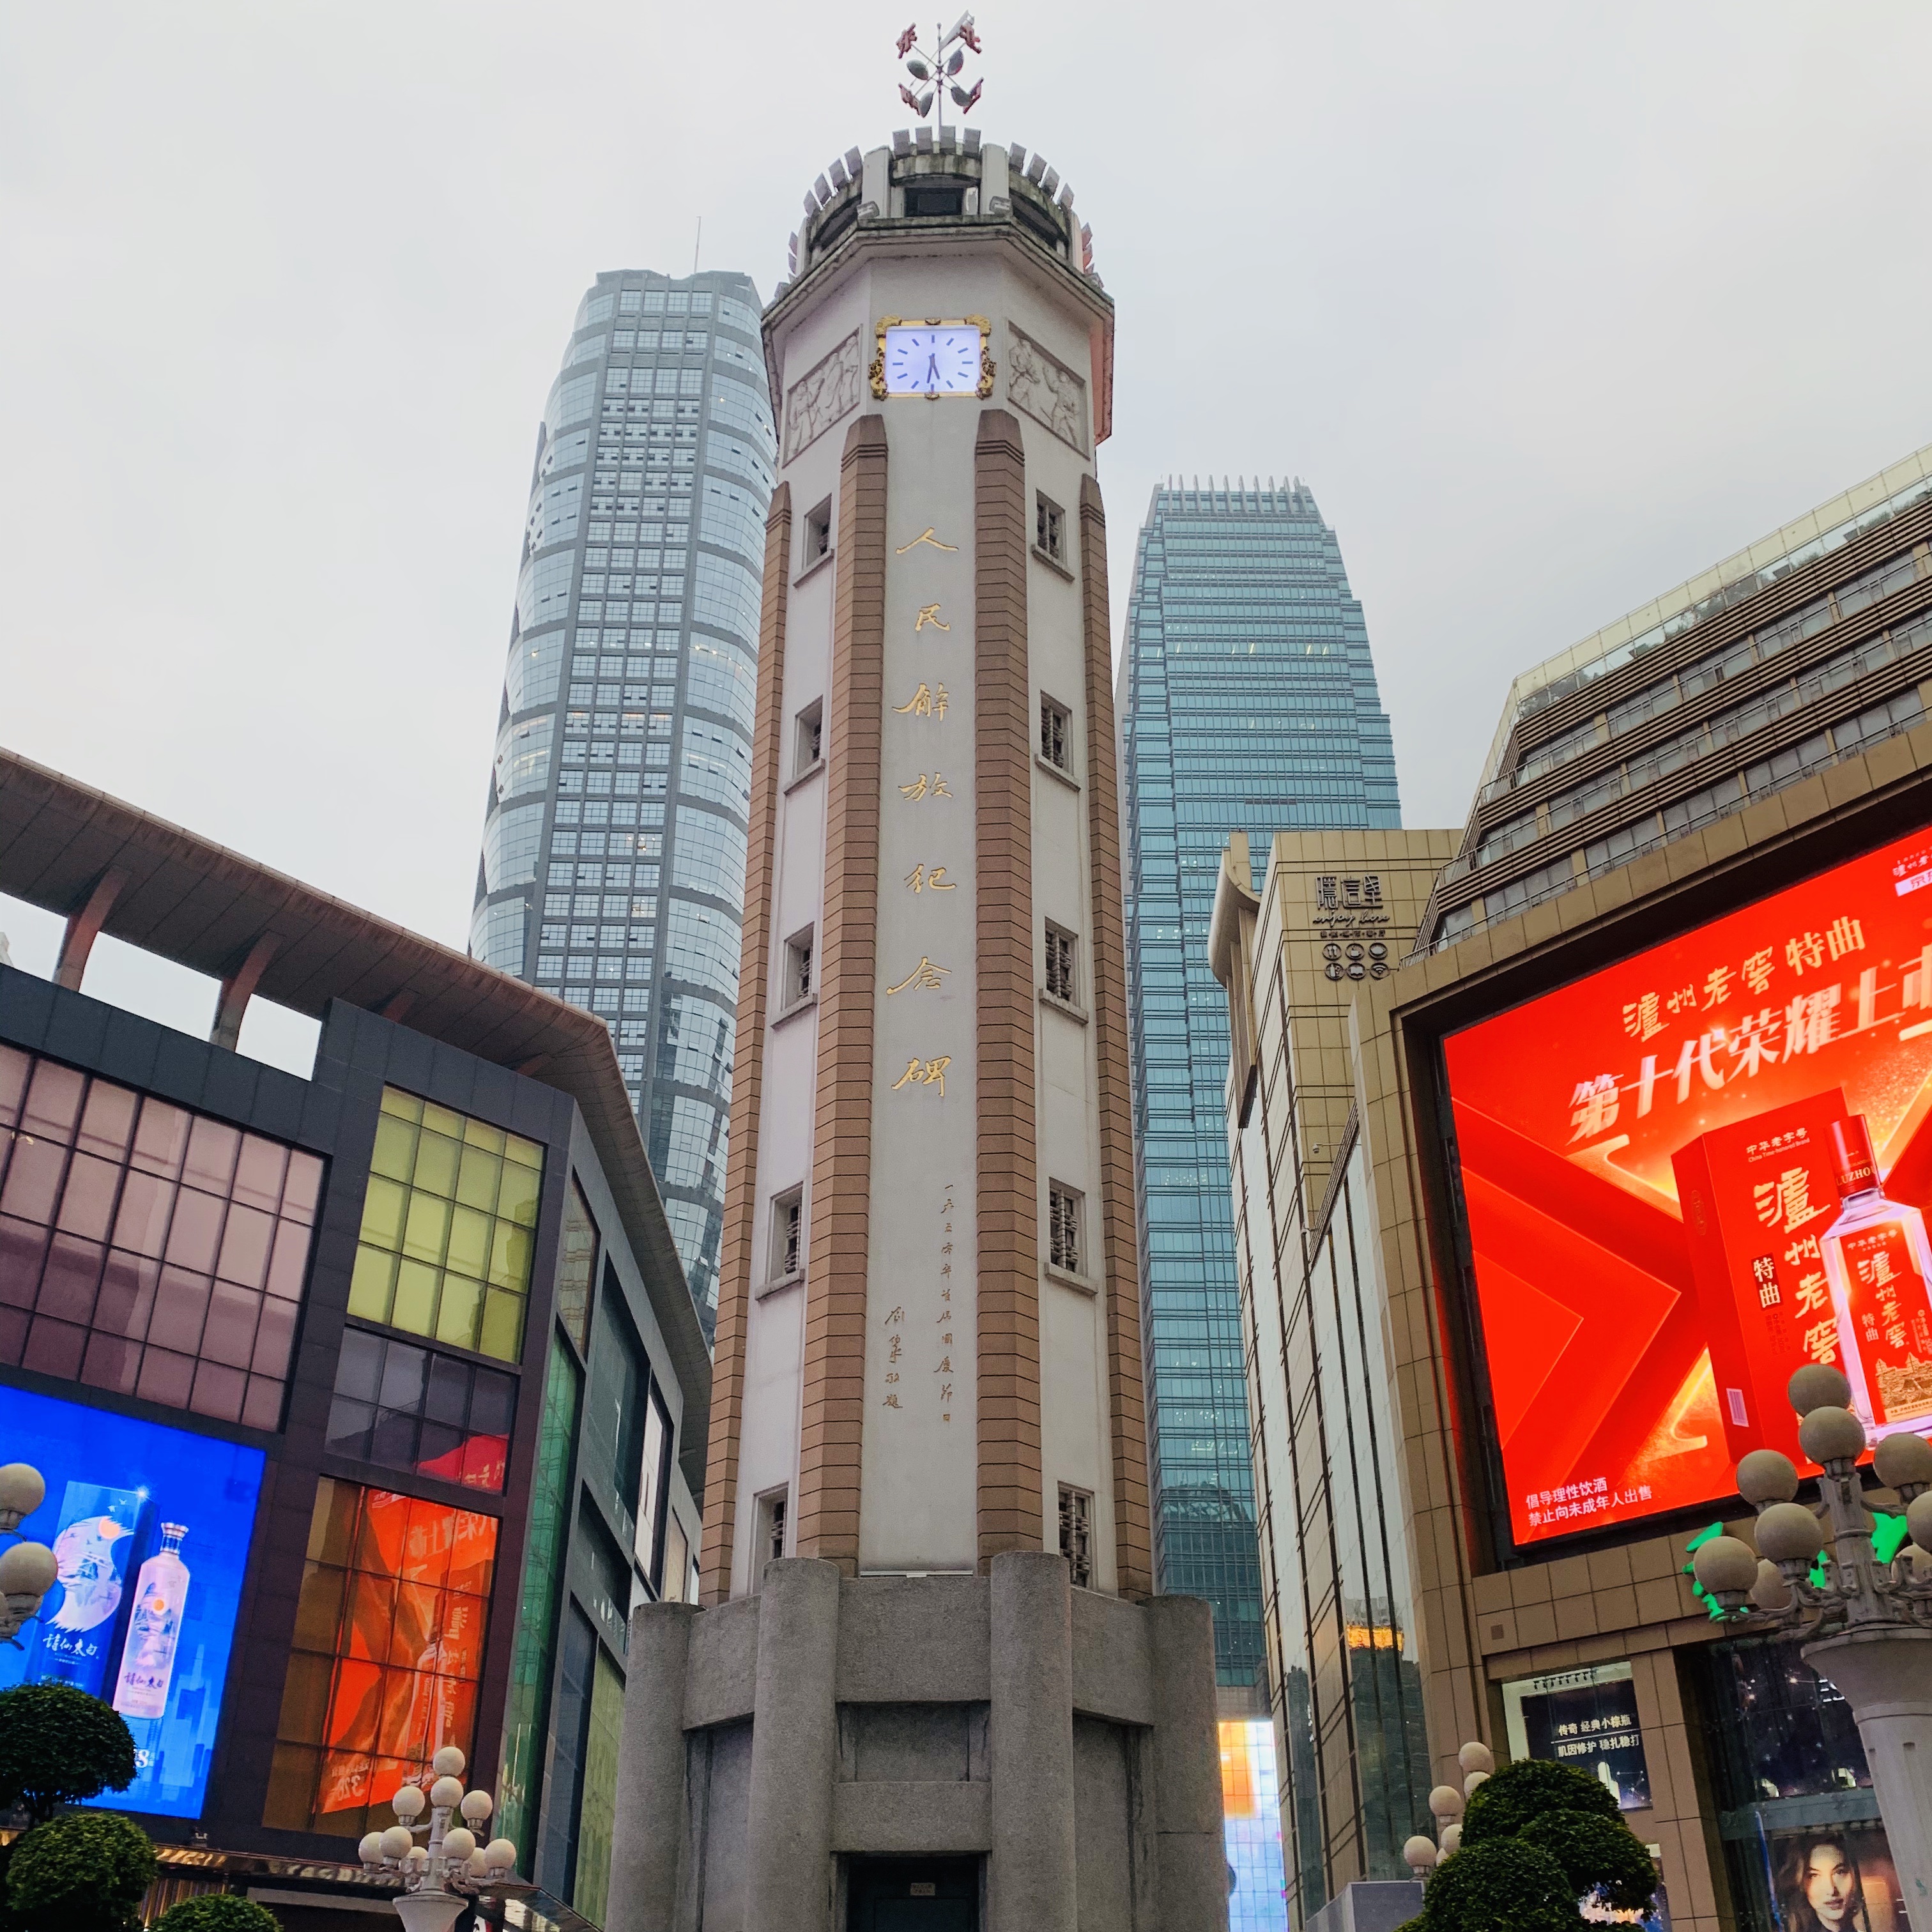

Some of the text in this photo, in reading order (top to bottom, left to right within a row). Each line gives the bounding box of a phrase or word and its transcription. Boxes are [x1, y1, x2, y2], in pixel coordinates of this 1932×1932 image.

[1313, 908, 1390, 928] enjoy here
[1746, 1128, 1807, 1154] 中华老字号
[1748, 1152, 1763, 1162] China
[1795, 1137, 1810, 1147] Brand
[1753, 1257, 1781, 1308] 特曲
[1862, 1313, 1879, 1342] 特曲
[1526, 1477, 1608, 1510] 倡导理性饮酒
[1528, 1485, 1652, 1527] 禁止向未成年人出售
[1558, 1714, 1632, 1736] 传奇 经典小棕瓶
[1558, 1734, 1640, 1757] 肌因修护 稳扎稳打
